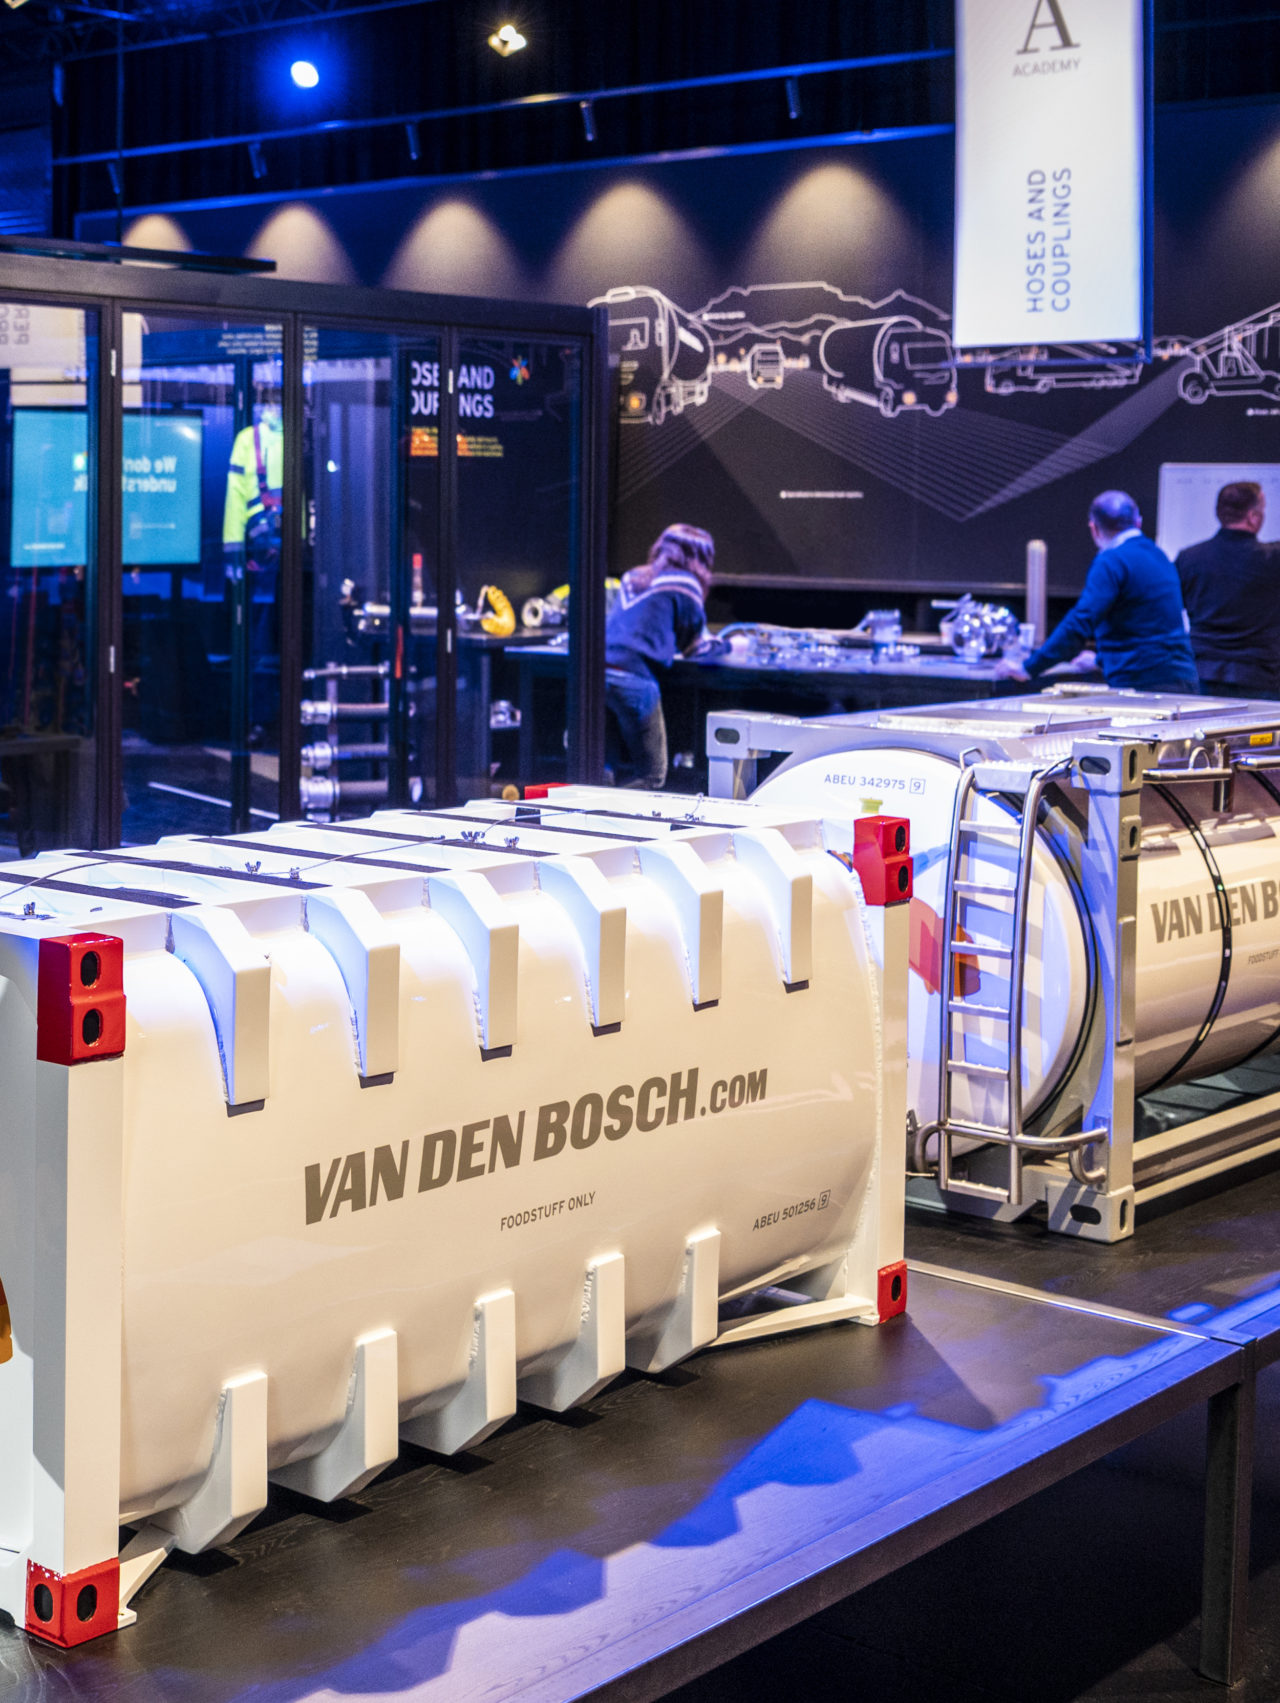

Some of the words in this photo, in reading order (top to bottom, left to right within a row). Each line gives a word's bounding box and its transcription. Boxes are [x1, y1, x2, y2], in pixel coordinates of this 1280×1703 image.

[1016, 0, 1081, 55] A
[1013, 58, 1081, 78] ACADEMY
[1027, 169, 1047, 222] AND
[1051, 167, 1072, 313] COUPLINGS
[1026, 230, 1046, 313] HOSES
[458, 364, 495, 390] AND
[824, 774, 856, 785] ABEU
[859, 776, 906, 790] 342975
[1150, 894, 1203, 944] VAN
[304, 1140, 409, 1225] VAN
[418, 1110, 526, 1193] DEN
[500, 1200, 565, 1231] FOODSTUFF
[568, 1191, 596, 1211] ONLY
[752, 1210, 780, 1231] ABEU
[782, 1198, 816, 1220] 501256
